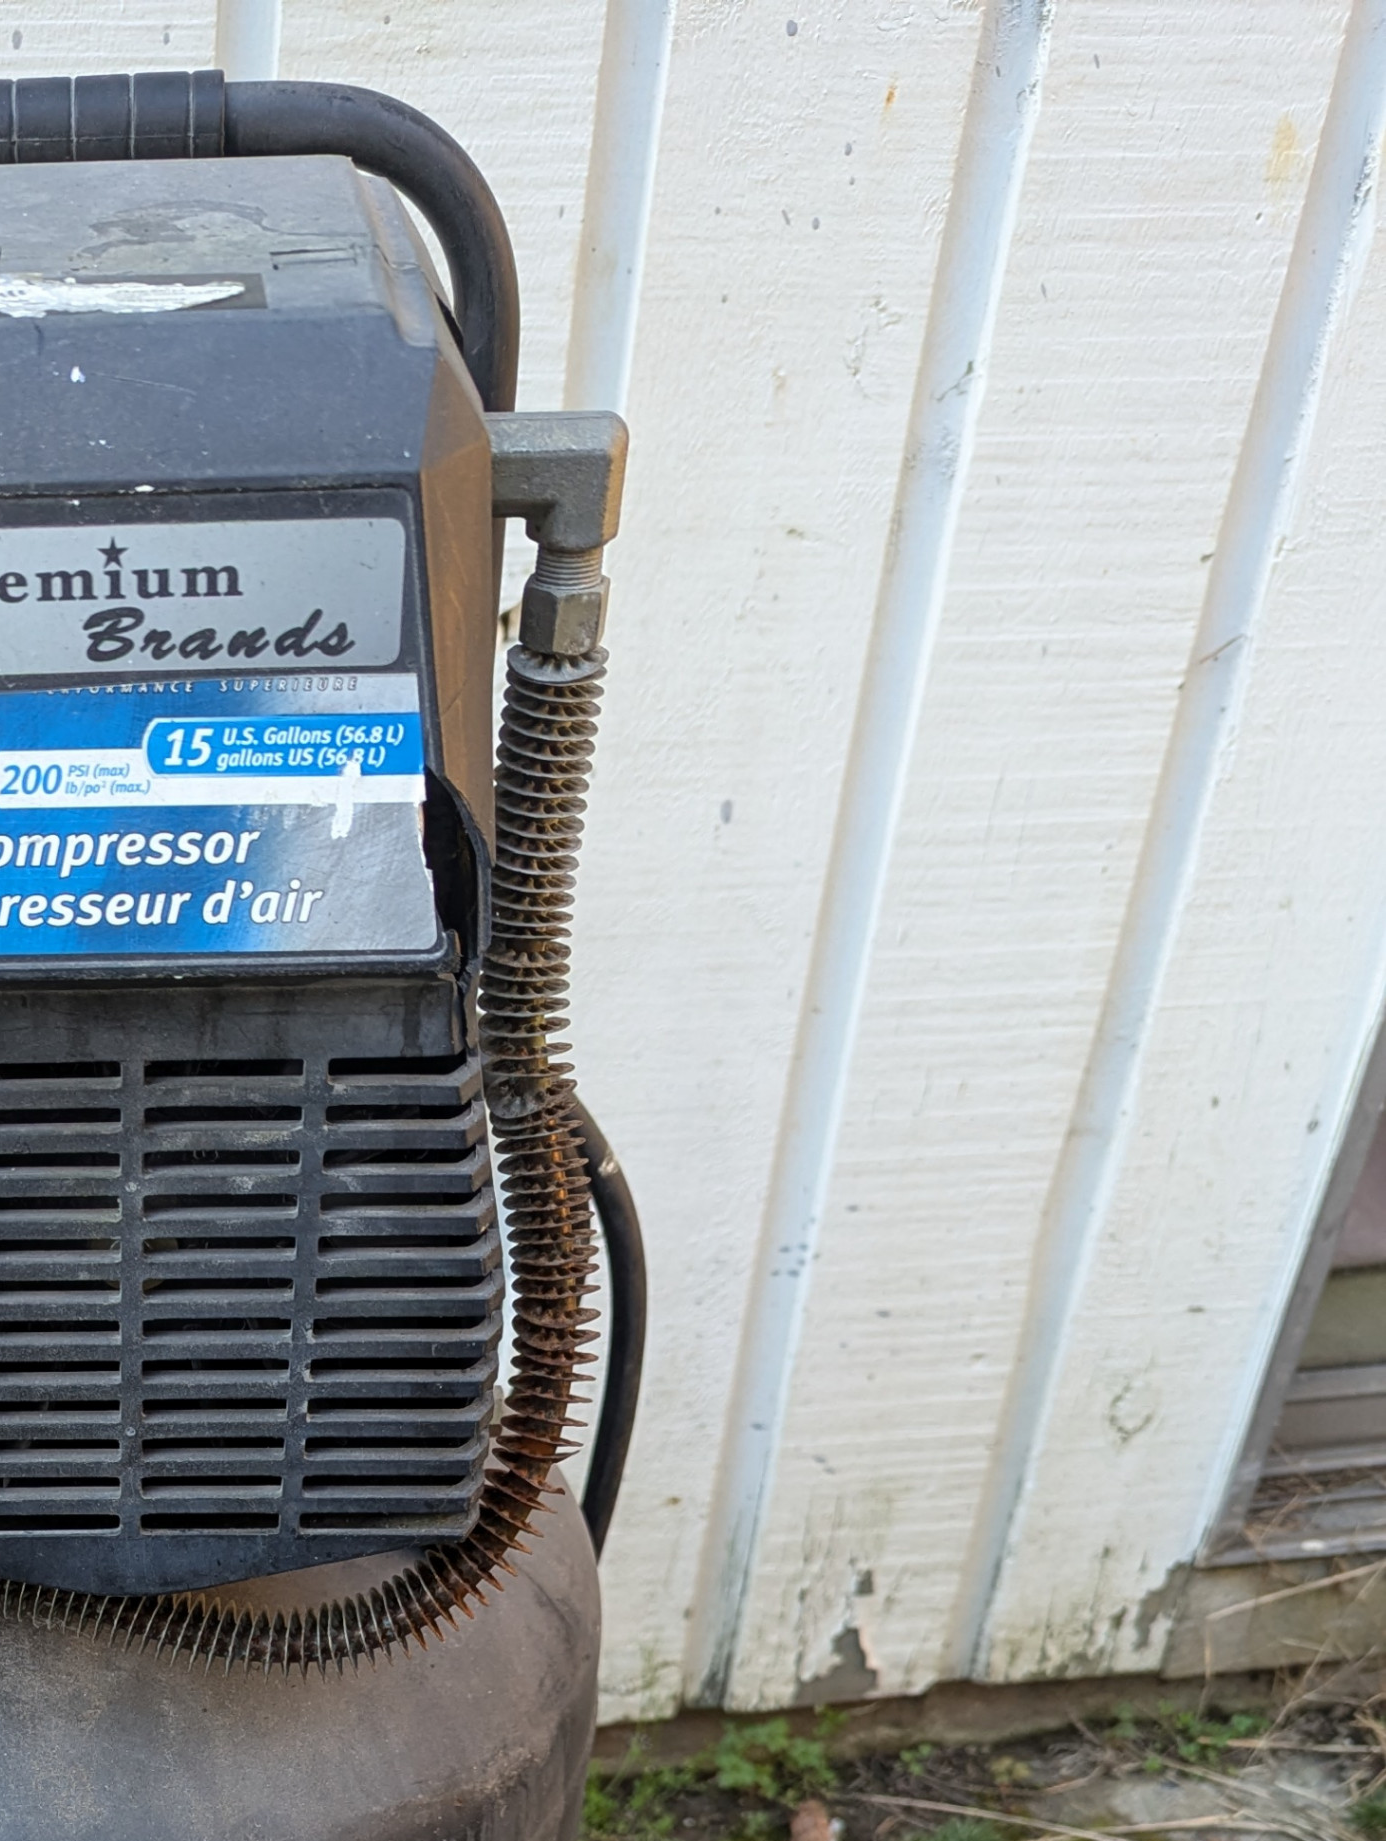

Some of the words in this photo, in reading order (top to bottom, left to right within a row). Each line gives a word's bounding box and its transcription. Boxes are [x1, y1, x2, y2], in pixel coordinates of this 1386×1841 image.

[82, 606, 356, 663] Brands
[164, 728, 214, 768] 15
[223, 728, 259, 746] U.S.
[263, 726, 332, 746] Gallons
[335, 725, 383, 746] (56.8
[386, 724, 405, 744] L)
[67, 764, 90, 777] PSI
[93, 763, 130, 779] (max)
[216, 750, 283, 771] gallons
[288, 749, 315, 767] US
[317, 748, 364, 769] (56.8
[367, 748, 387, 767] L)
[0, 764, 63, 795] 200
[109, 779, 152, 796] (max.)
[201, 878, 325, 926] d'air
